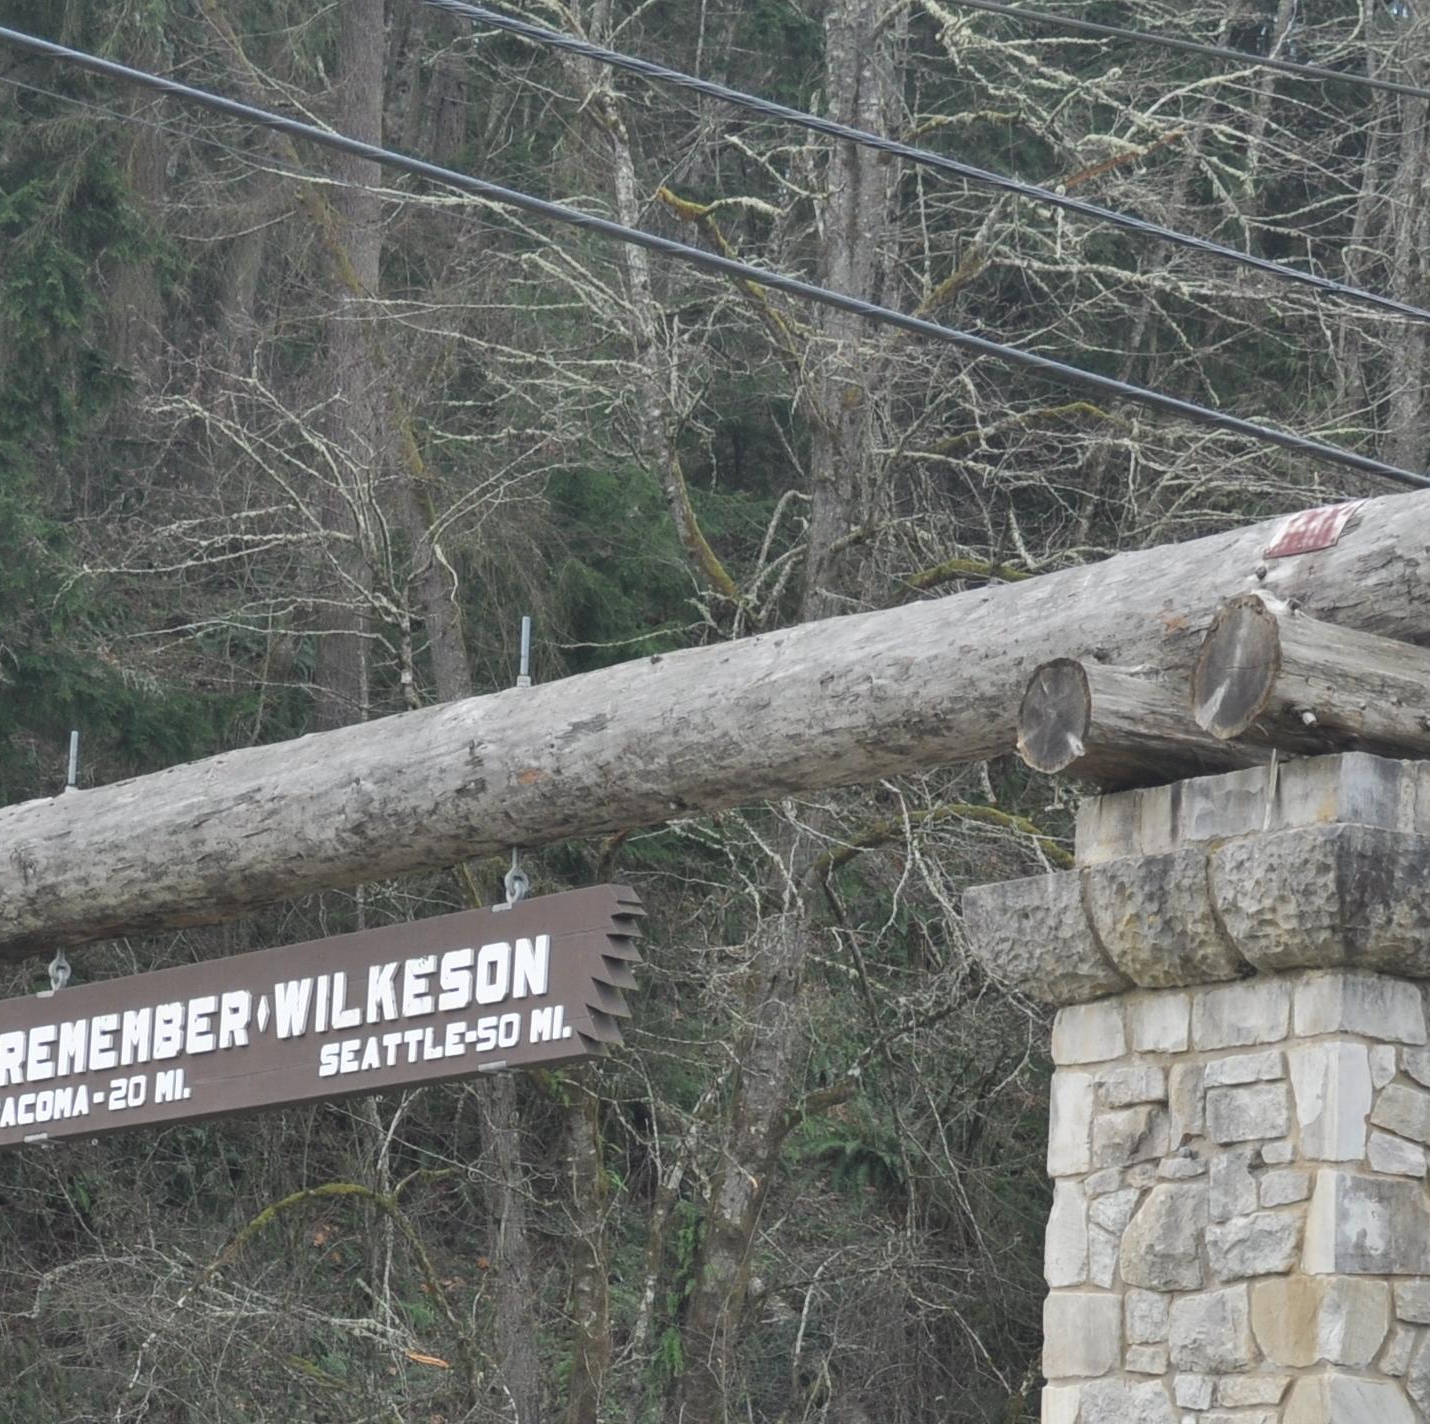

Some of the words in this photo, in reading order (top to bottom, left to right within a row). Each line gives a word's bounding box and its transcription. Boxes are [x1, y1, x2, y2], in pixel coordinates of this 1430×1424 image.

[274, 934, 551, 1039] WILKESON
[530, 1004, 572, 1043] MI.
[154, 1068, 192, 1104] MI.
